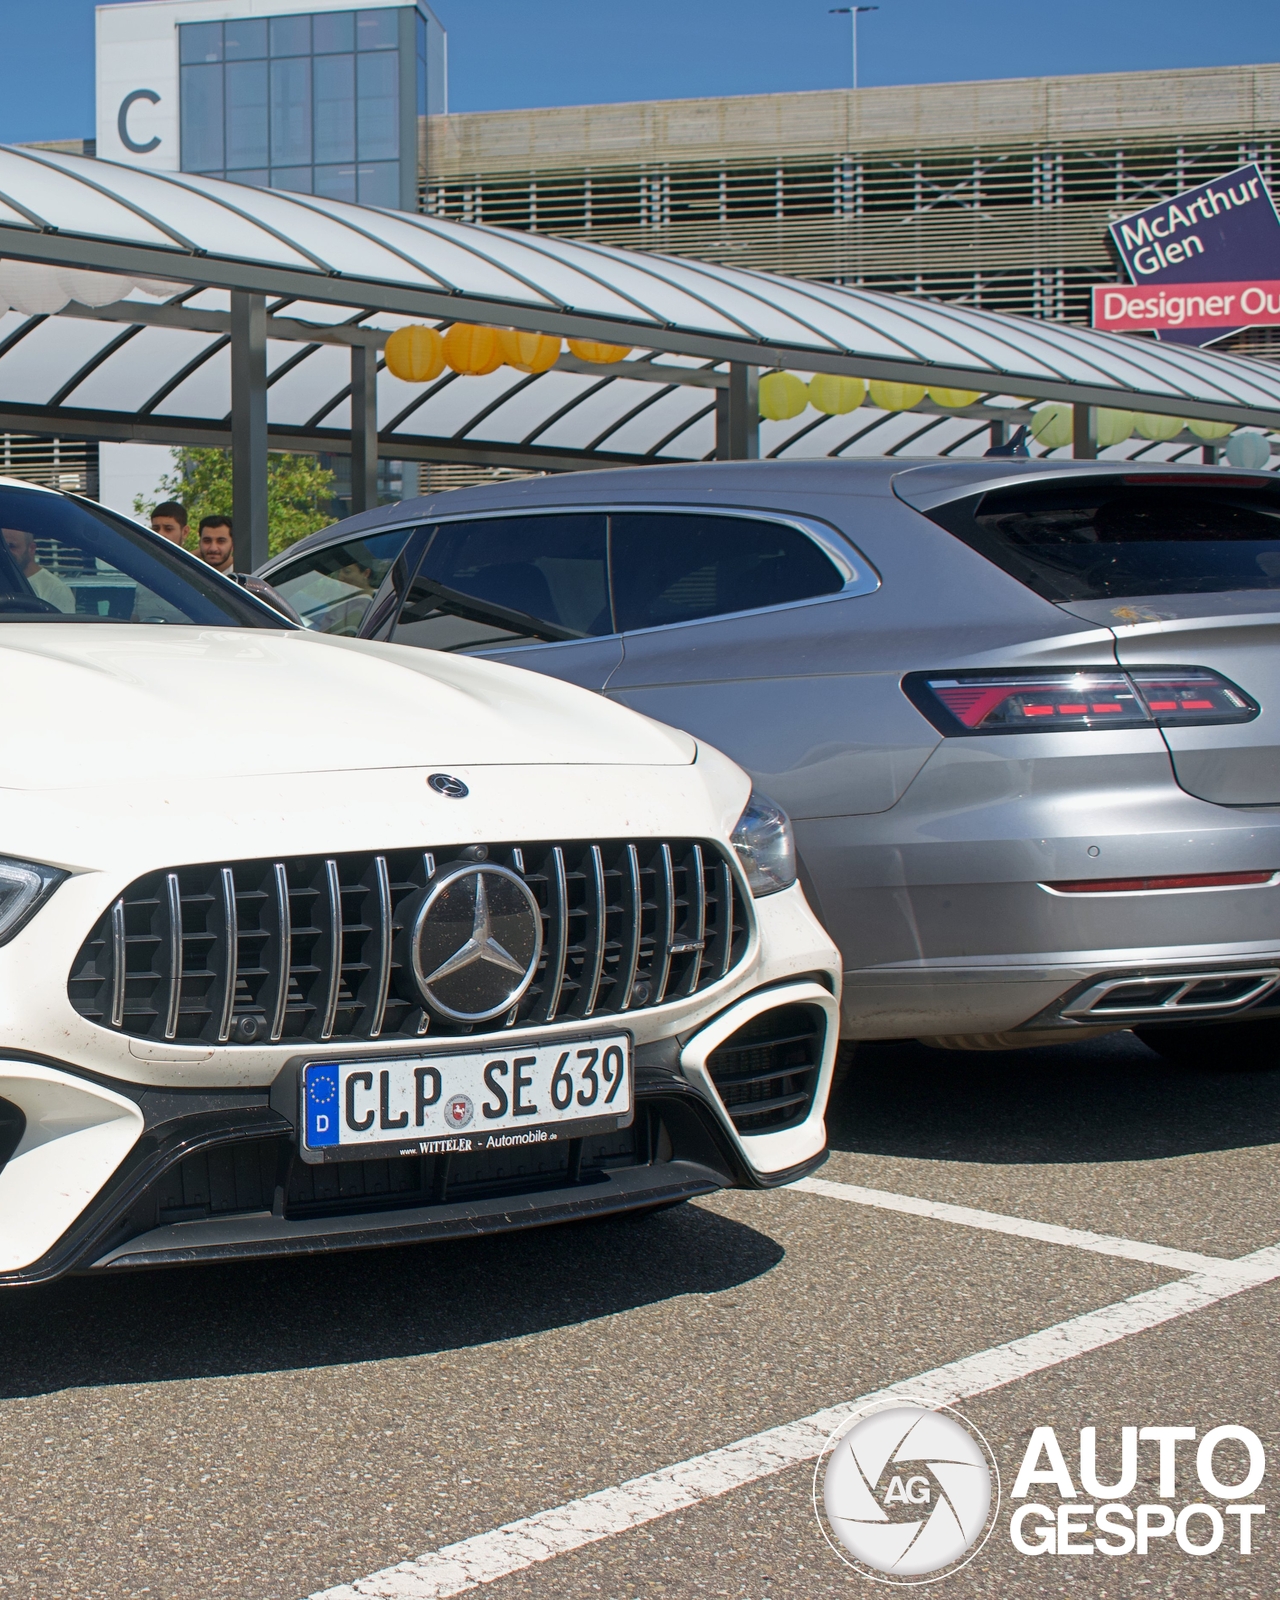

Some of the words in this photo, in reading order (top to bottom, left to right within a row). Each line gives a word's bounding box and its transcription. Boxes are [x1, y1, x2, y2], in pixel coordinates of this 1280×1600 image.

[117, 88, 162, 154] C
[1120, 177, 1259, 250] McArthur
[1133, 233, 1205, 275] Glen
[1103, 291, 1236, 325] Designer
[345, 1066, 442, 1131] CLP
[482, 1056, 538, 1119] SE
[550, 1045, 623, 1110] 639
[316, 1114, 329, 1132] D
[419, 1138, 472, 1154] WITTELER
